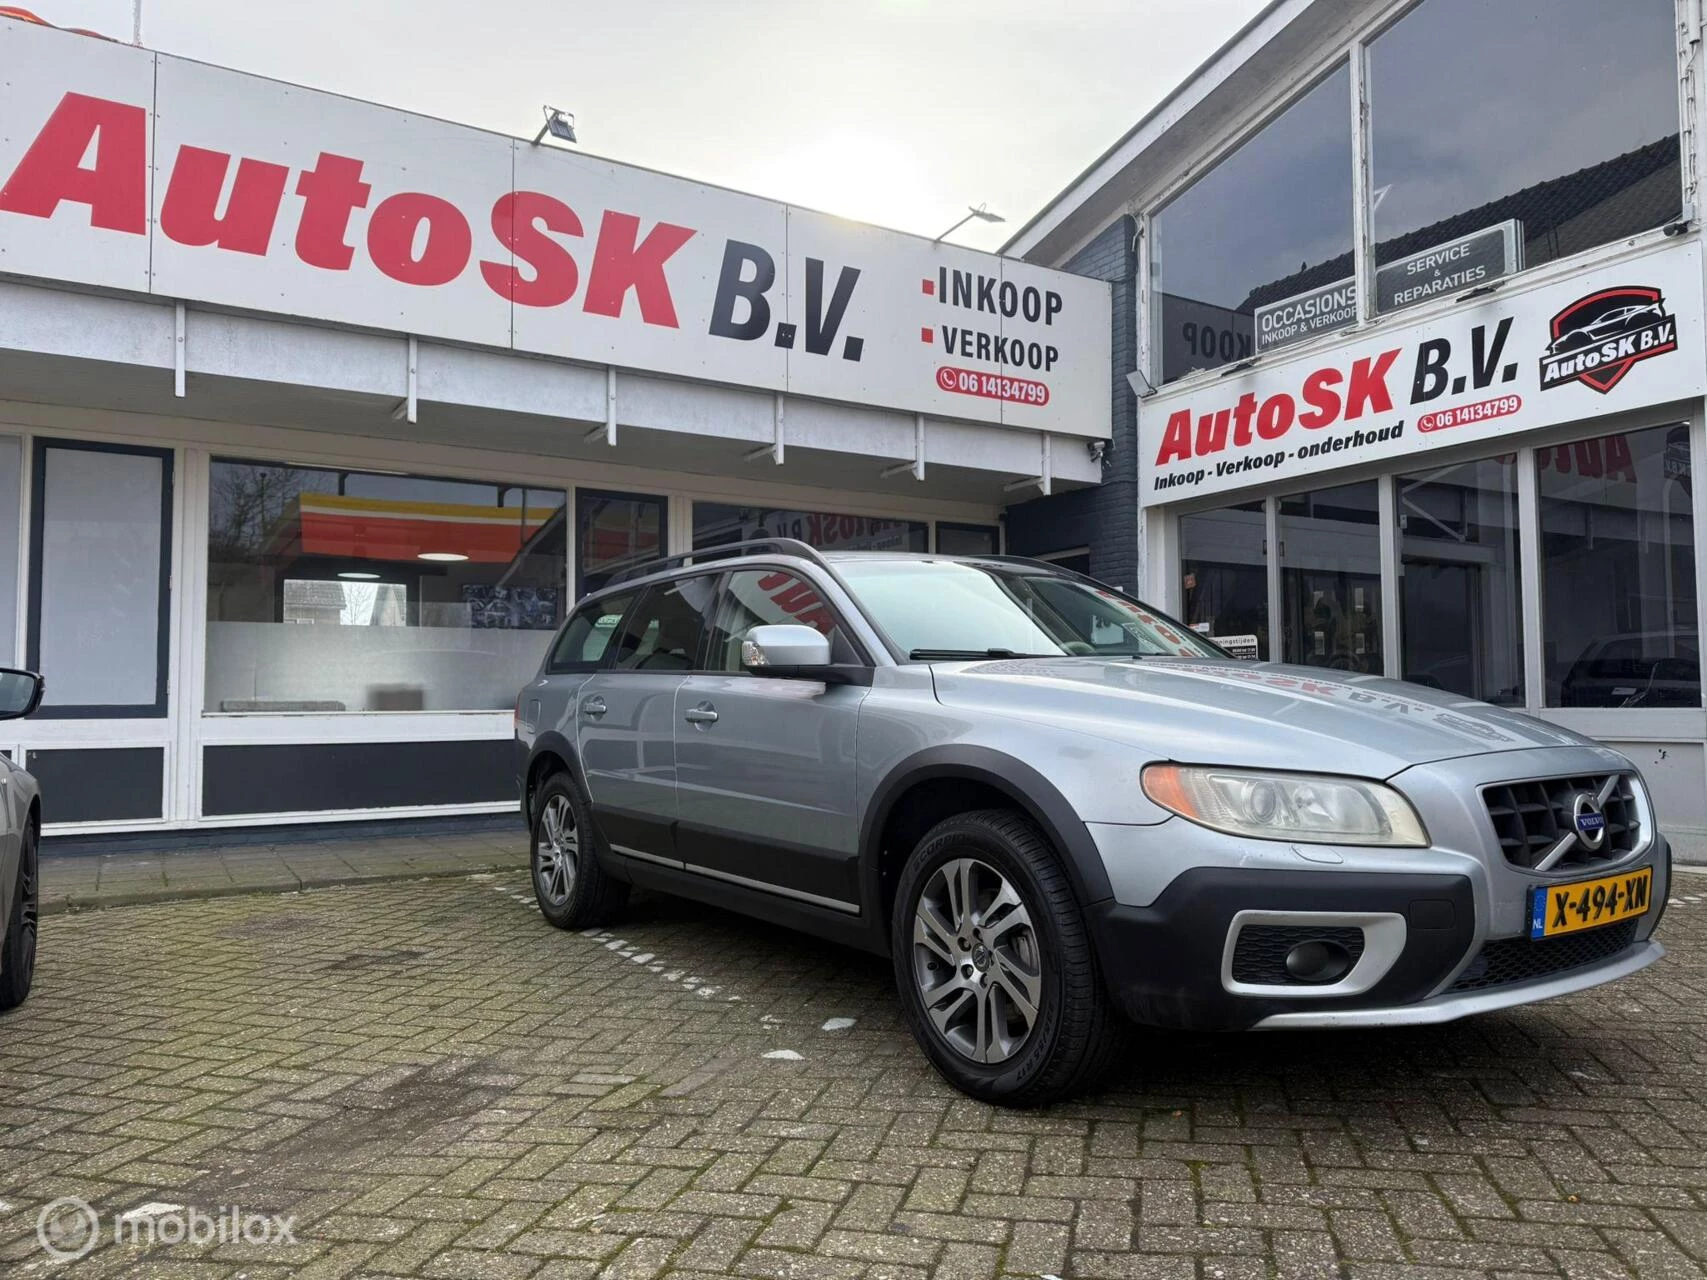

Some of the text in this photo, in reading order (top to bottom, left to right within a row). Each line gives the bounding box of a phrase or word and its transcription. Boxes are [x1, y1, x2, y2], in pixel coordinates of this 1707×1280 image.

[0, 91, 864, 362] AutoSK B.V.
[1406, 243, 1471, 276] SERVICE
[1433, 269, 1441, 277] &
[939, 266, 1063, 326] INKOOP
[1261, 285, 1358, 331] OCCASIONS
[1393, 265, 1486, 306] REPARATIES
[941, 326, 1060, 371] VERKOOP
[1261, 325, 1298, 345] INKOOP
[1299, 321, 1308, 332] &
[1543, 323, 1675, 383] AutoSK B.V.
[959, 372, 1046, 403] 06 14134799
[1154, 316, 1518, 466] AutoSK B.V.
[1436, 396, 1518, 427] 06 14134799
[1154, 468, 1205, 491] Inkoop
[1216, 450, 1285, 477] Verkoop
[1297, 420, 1404, 459] onderhoud
[1532, 918, 1543, 930] NL
[1552, 875, 1649, 928] X-494-XN
